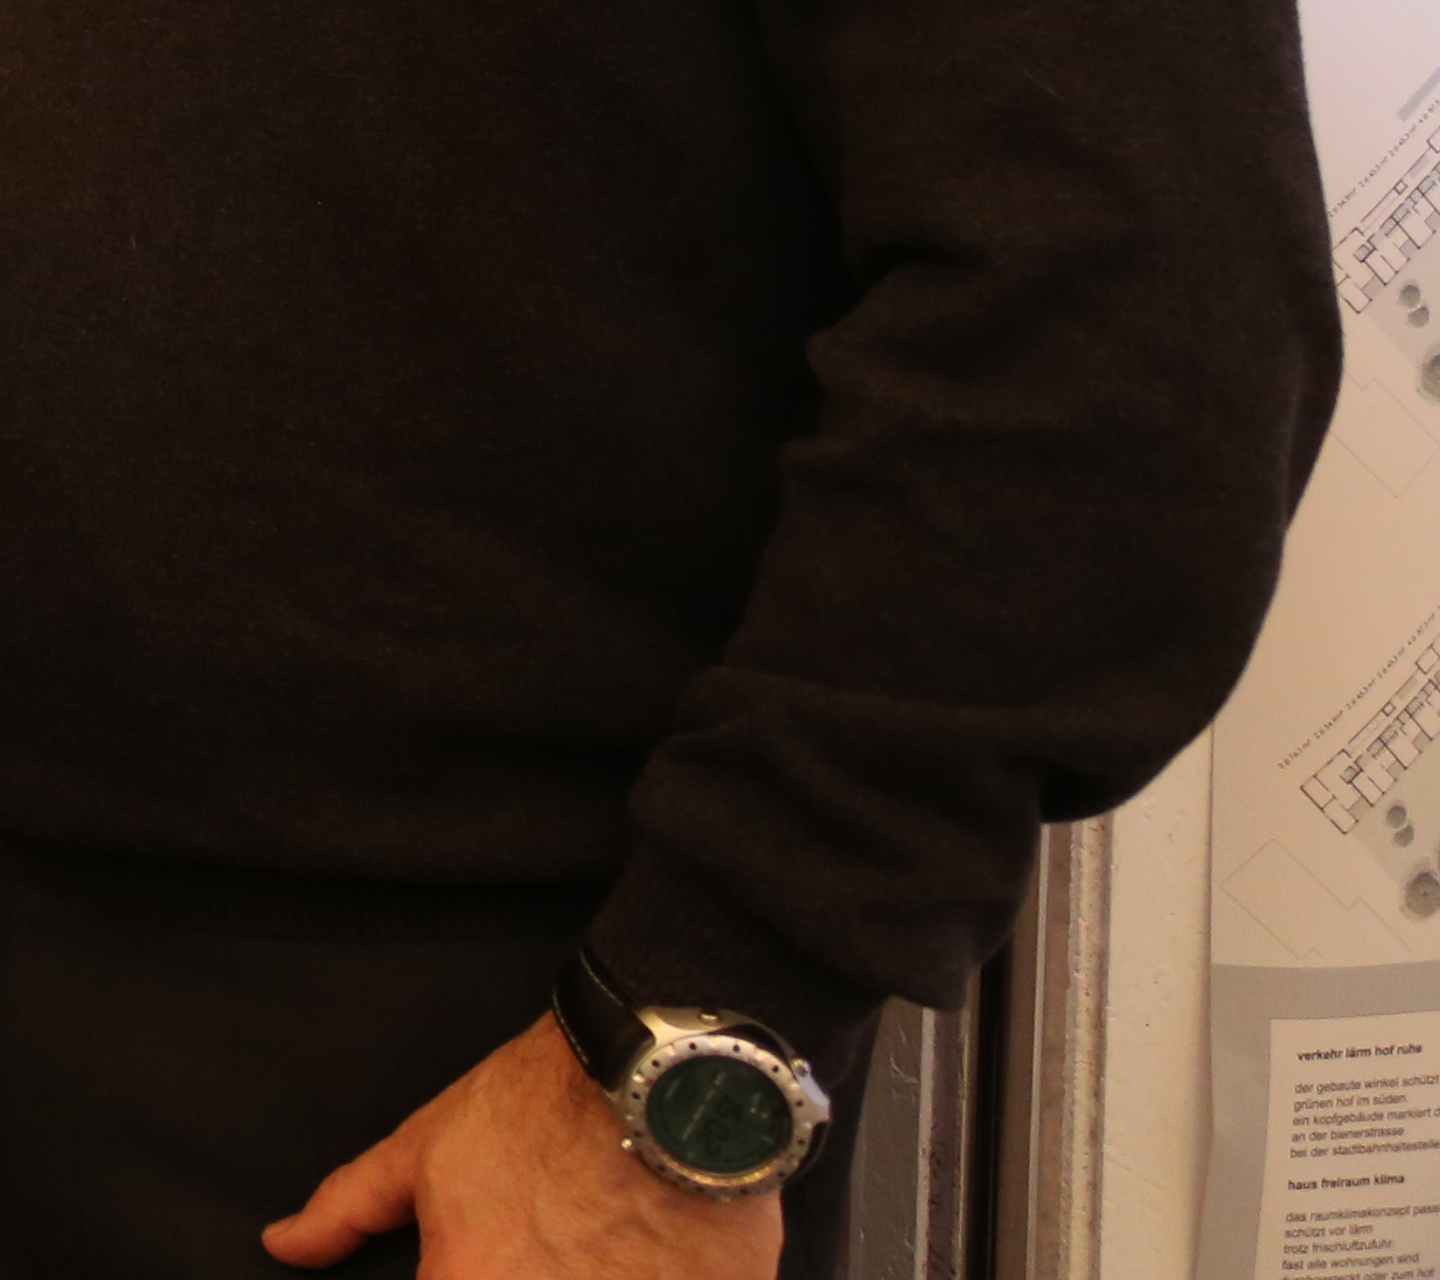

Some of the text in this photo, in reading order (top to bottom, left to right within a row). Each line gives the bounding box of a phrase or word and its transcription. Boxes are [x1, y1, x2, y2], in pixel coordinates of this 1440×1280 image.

[1297, 1049, 1343, 1061] verkehr
[1375, 1044, 1396, 1056] hof
[1397, 1043, 1423, 1055] ruhe
[1294, 1083, 1314, 1094] der
[1336, 1096, 1355, 1108] hof
[1356, 1096, 1370, 1107] im
[1308, 1130, 1328, 1142] der
[1287, 1174, 1405, 1191] haus freiraum klima
